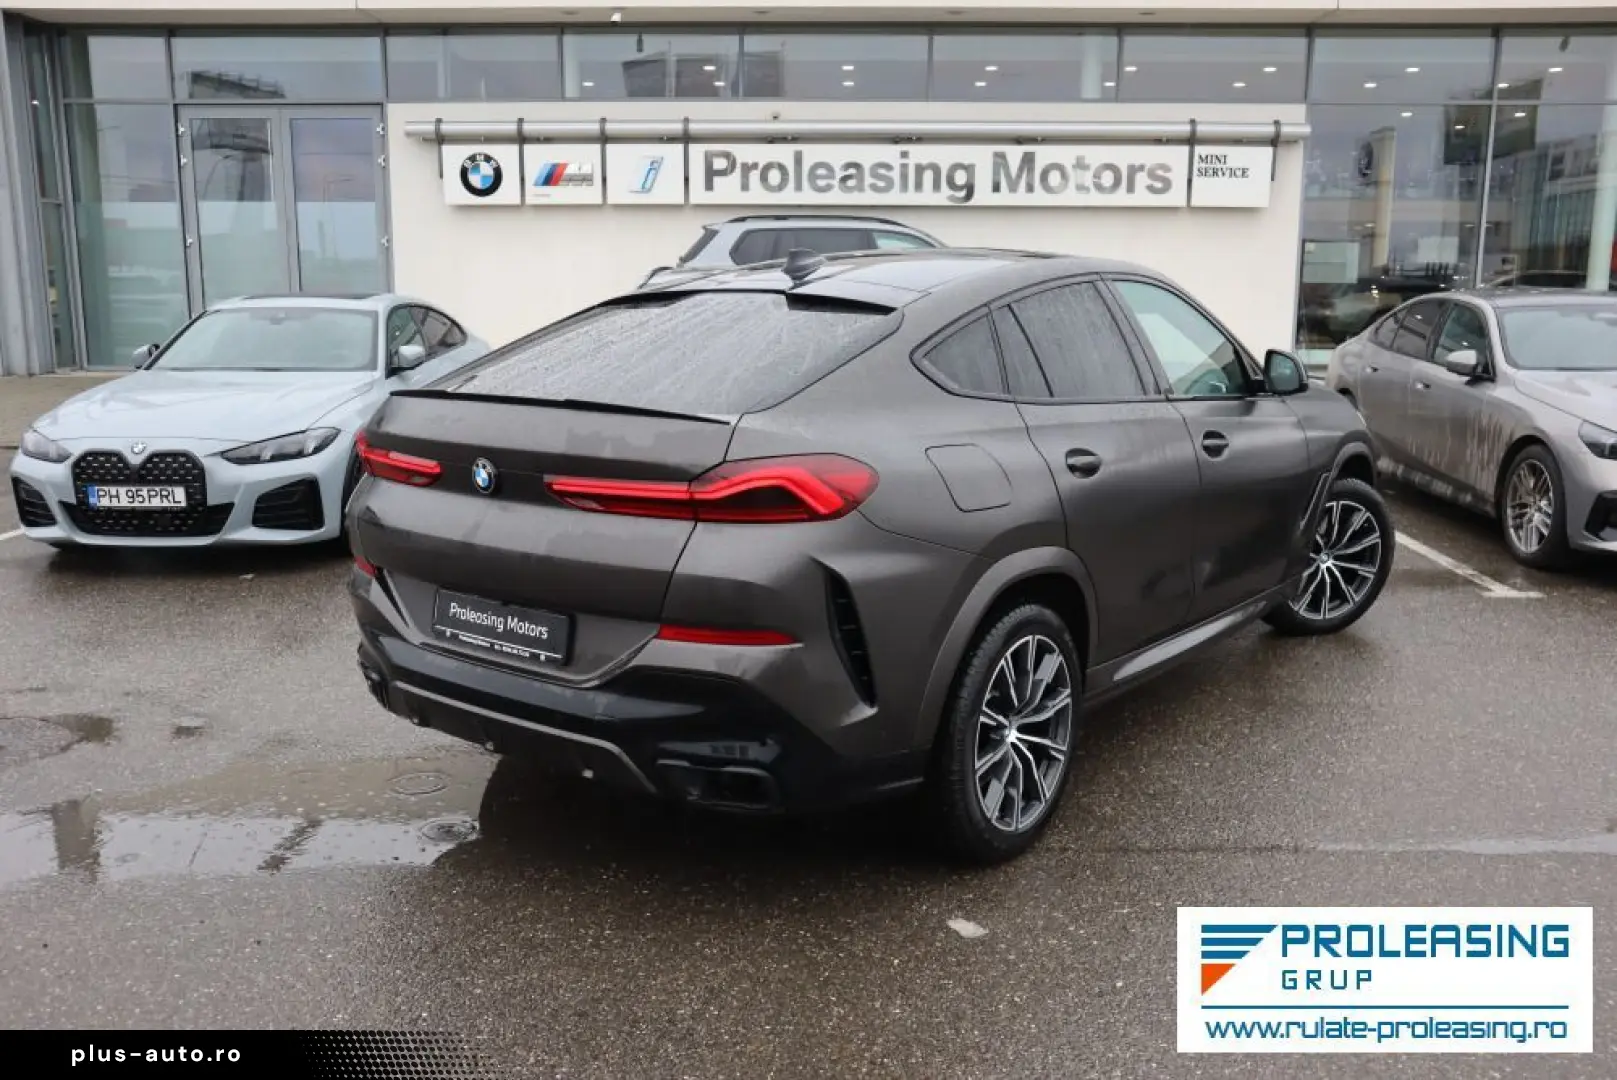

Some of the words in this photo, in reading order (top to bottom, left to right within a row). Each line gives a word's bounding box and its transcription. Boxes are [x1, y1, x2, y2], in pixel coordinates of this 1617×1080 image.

[1197, 153, 1229, 166] MINI
[703, 149, 976, 204] Proleasing
[991, 150, 1173, 195] Motors
[1196, 166, 1249, 179] SERVICE
[97, 488, 120, 504] PH
[449, 602, 503, 632] Proleasing
[507, 615, 549, 640] Motors
